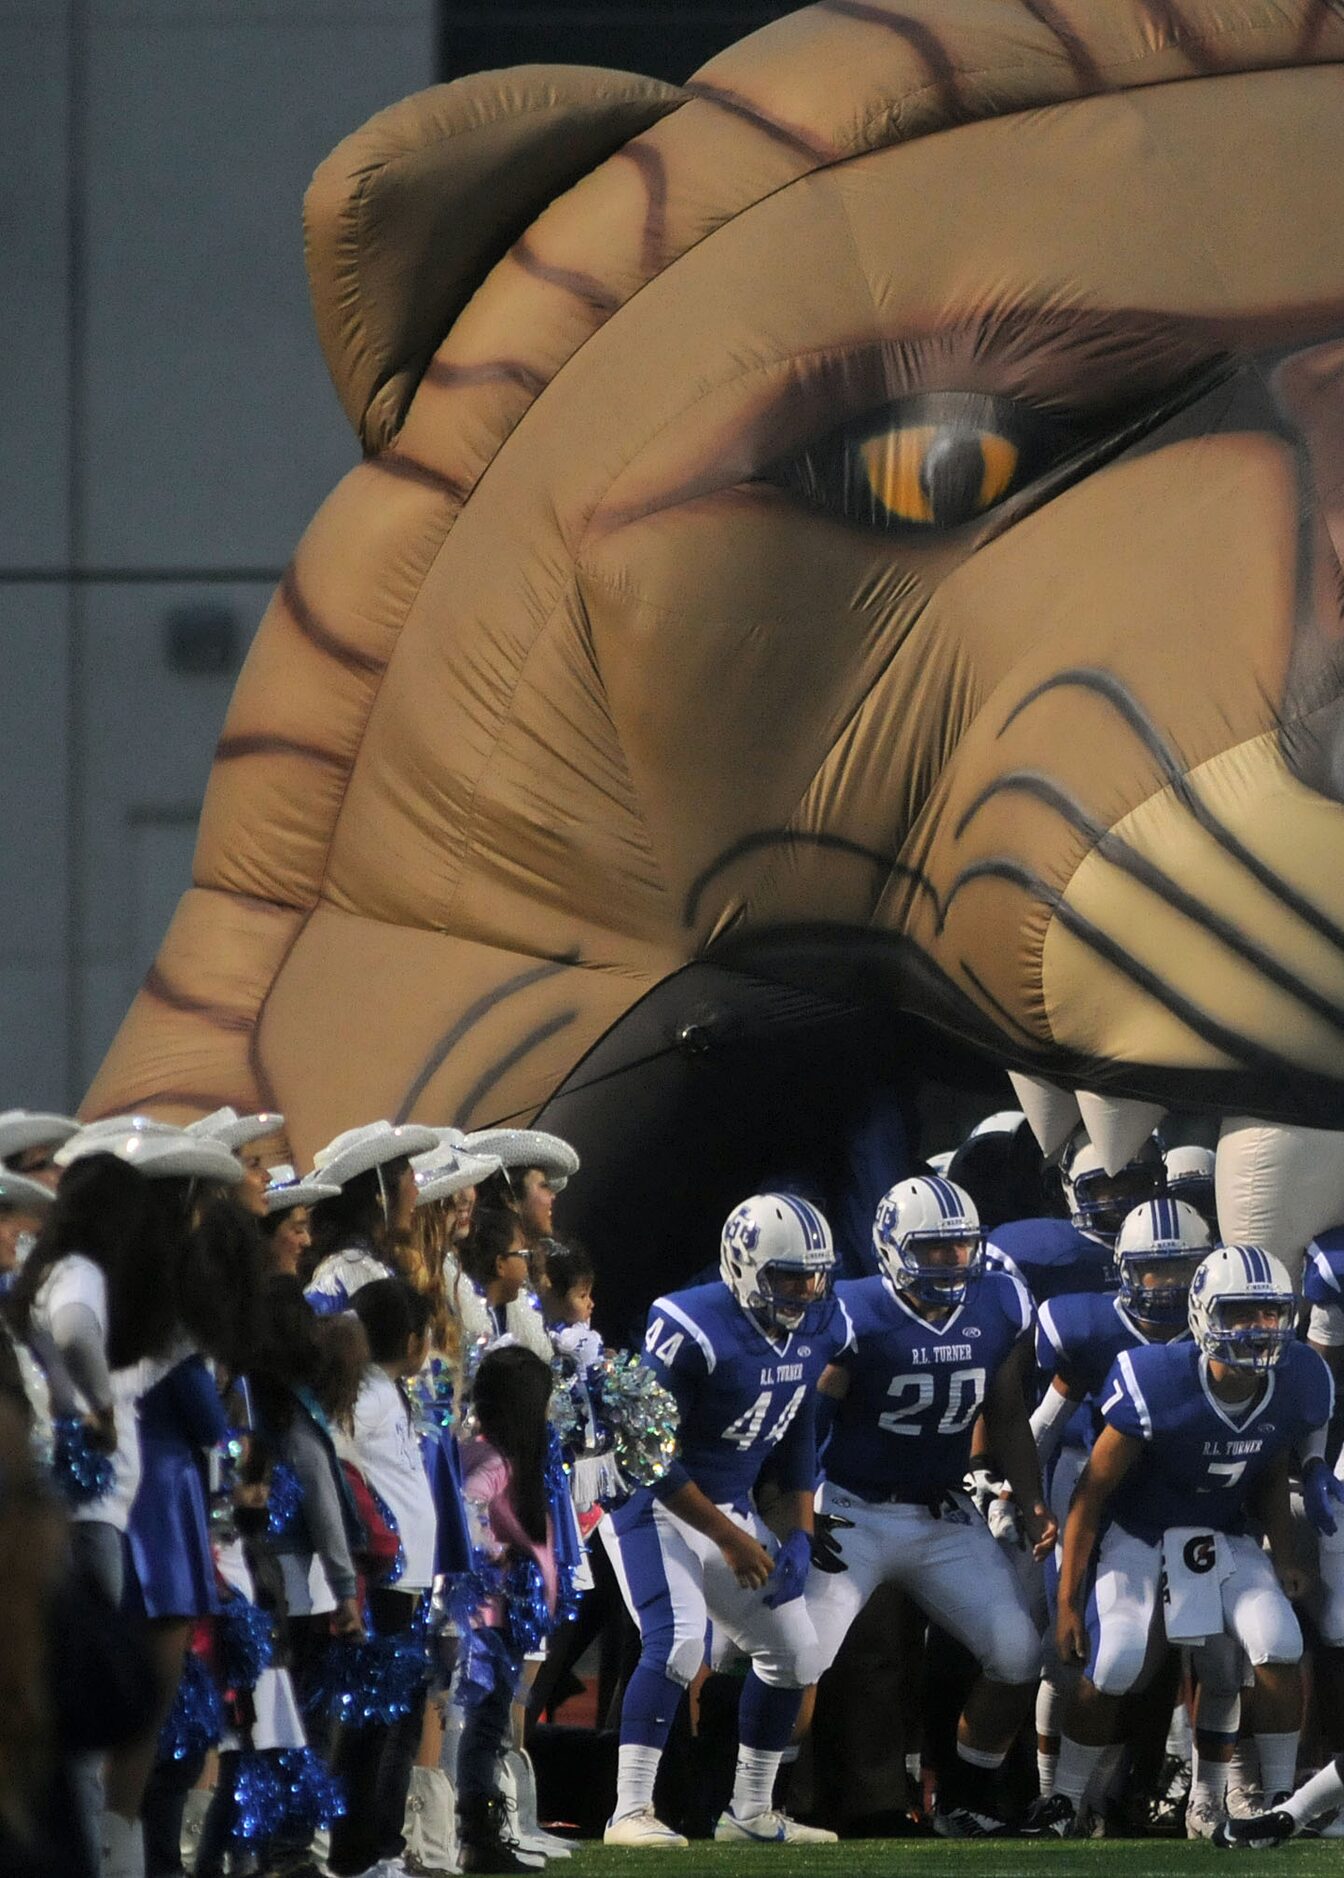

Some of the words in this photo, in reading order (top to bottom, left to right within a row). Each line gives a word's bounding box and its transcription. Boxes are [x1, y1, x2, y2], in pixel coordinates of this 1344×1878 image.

[644, 1317, 685, 1368] 44
[912, 1347, 931, 1365] R.L.
[933, 1343, 972, 1363] TURNER
[776, 1362, 803, 1383] TURNER
[720, 1384, 807, 1451] 44
[878, 1367, 987, 1436] 20
[1203, 1441, 1221, 1456] R.L.
[1225, 1439, 1263, 1456] TURNER
[1196, 1460, 1248, 1493] 7
[1183, 1535, 1216, 1574] G
